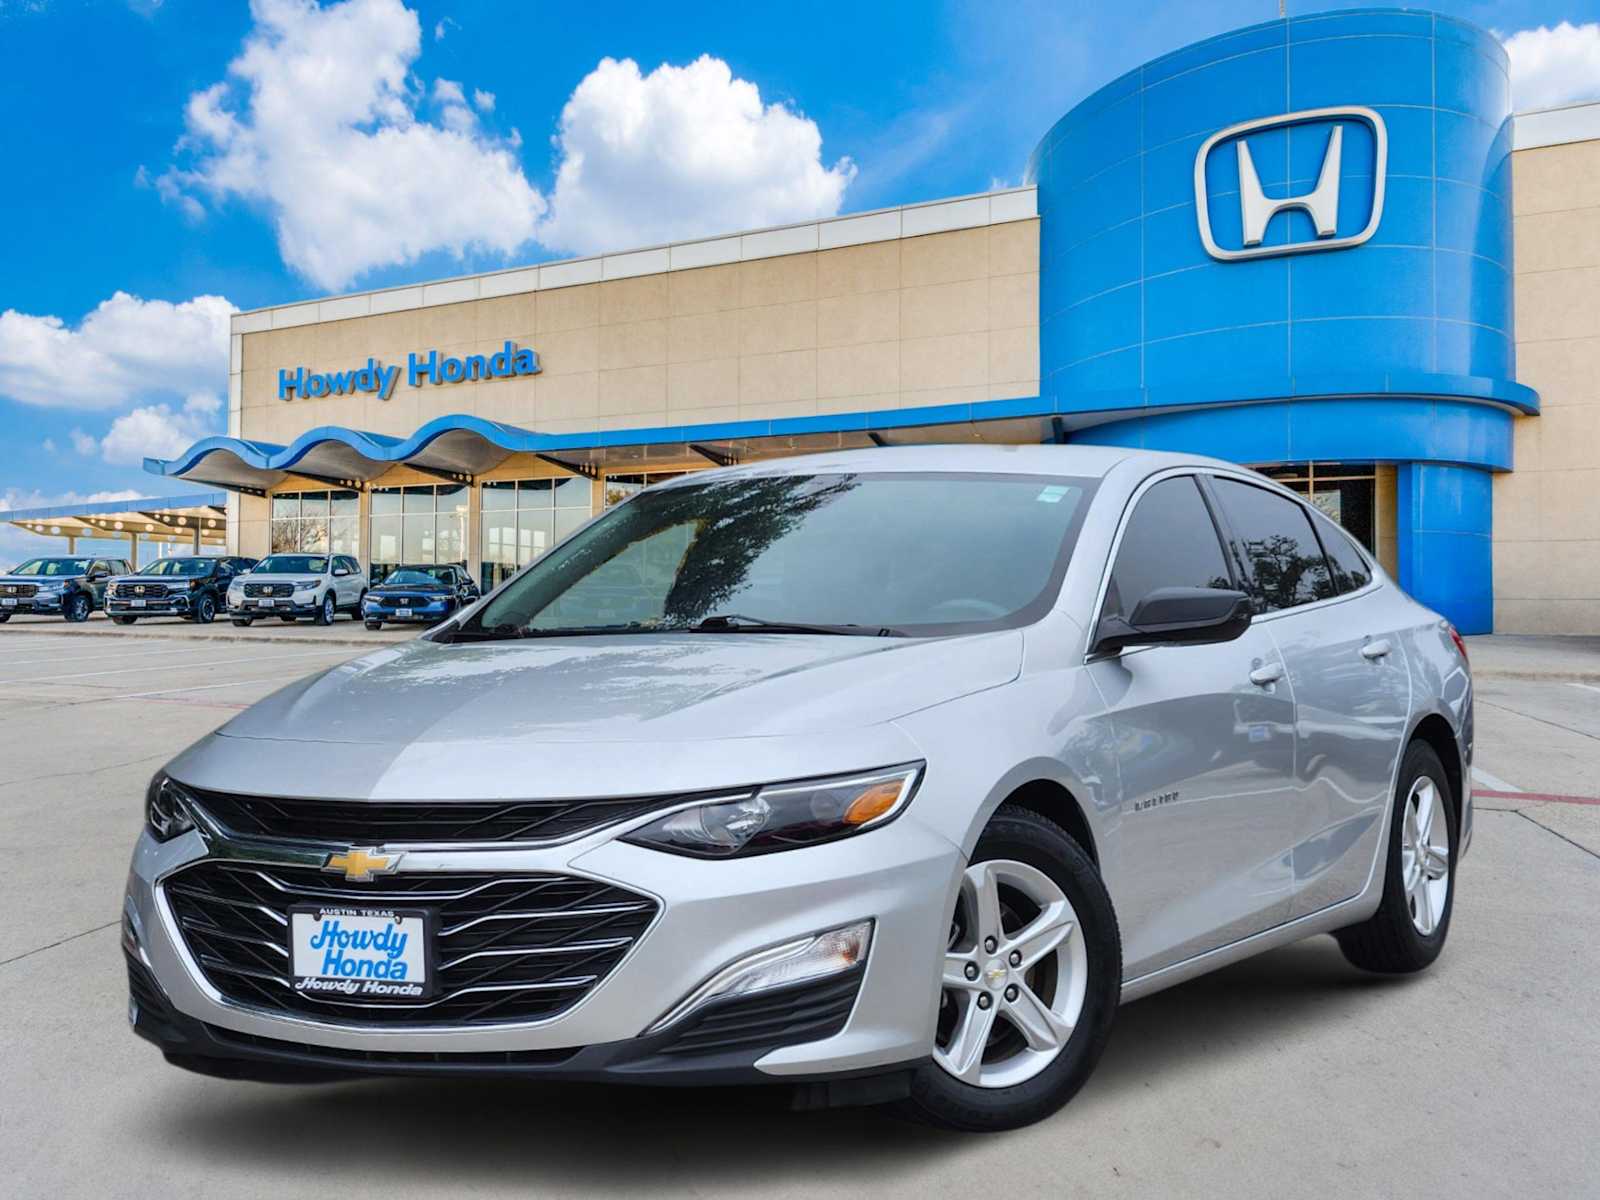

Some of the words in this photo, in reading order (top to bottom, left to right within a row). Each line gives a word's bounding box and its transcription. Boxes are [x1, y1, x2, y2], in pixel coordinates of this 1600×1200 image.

[278, 358, 400, 400] Howdy
[408, 341, 542, 387] Honda
[319, 908, 357, 916] AUSTIN
[360, 909, 395, 918] TEXAS
[310, 920, 408, 959] Howdy
[321, 949, 408, 980] Honda
[295, 976, 361, 995] Howdy
[362, 981, 423, 996] Honda
